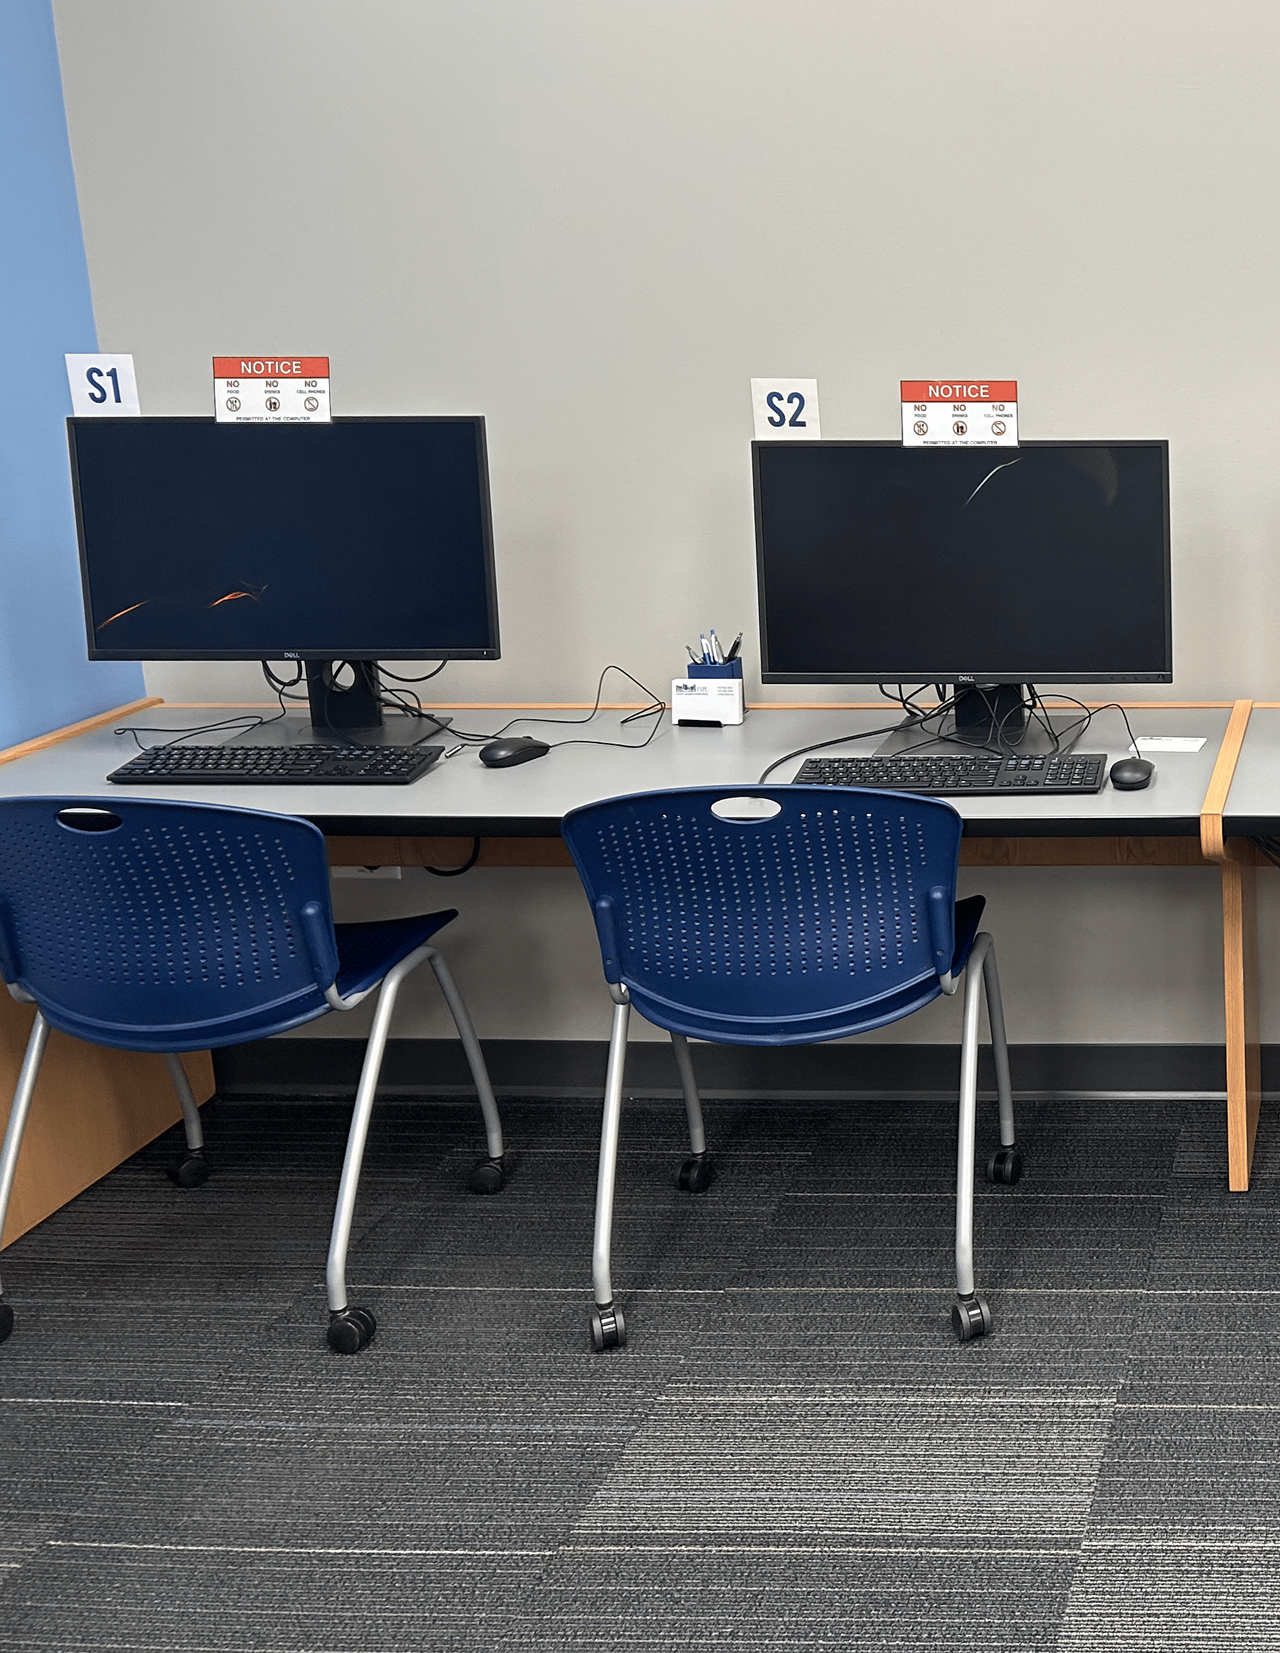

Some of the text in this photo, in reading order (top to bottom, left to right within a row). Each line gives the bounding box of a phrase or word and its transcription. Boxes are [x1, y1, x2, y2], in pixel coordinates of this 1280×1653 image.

[241, 361, 303, 375] NOTICE
[86, 367, 122, 403] S1
[226, 380, 240, 388] NO
[265, 380, 279, 388] NO
[304, 380, 318, 388] NO
[928, 384, 991, 398] NOTICE
[767, 391, 807, 428] S2
[913, 404, 927, 412] NO
[953, 404, 967, 412] NO
[991, 404, 1006, 412] NO
